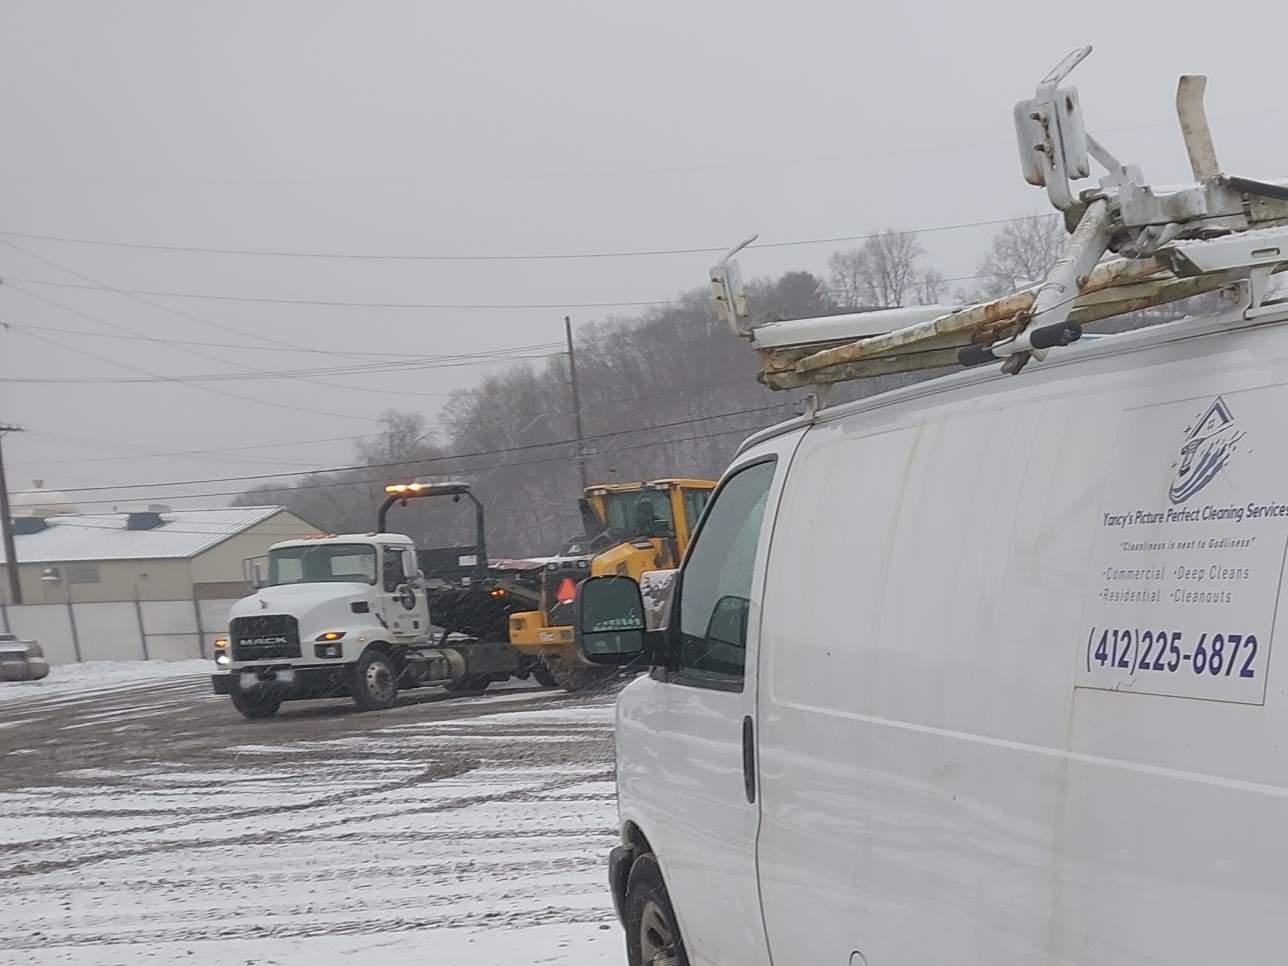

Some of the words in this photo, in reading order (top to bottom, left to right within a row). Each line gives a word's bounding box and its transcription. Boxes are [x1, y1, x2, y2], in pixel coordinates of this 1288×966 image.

[1103, 511, 1133, 528] Yancy's
[1134, 509, 1164, 524] Picture
[1166, 506, 1201, 522] Perfect
[1202, 503, 1244, 523] Cleaning
[1208, 564, 1250, 580] Cleans
[1087, 627, 1258, 678] (412)225-6872
